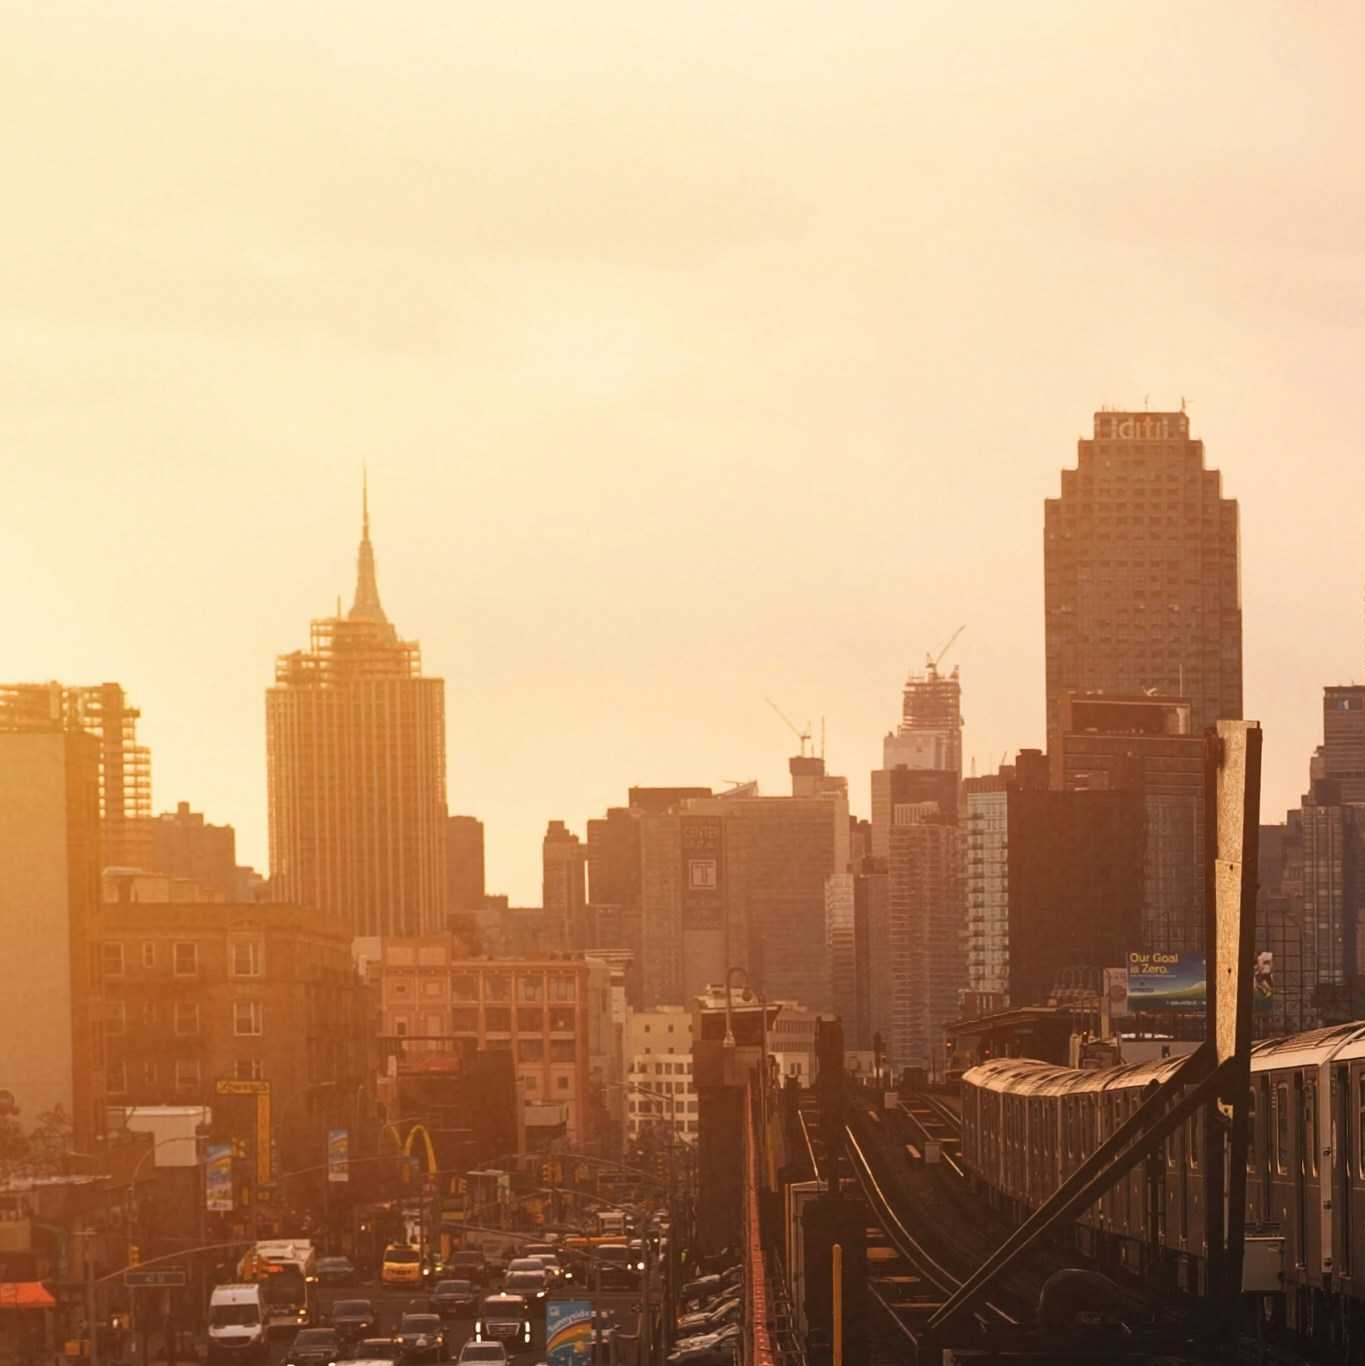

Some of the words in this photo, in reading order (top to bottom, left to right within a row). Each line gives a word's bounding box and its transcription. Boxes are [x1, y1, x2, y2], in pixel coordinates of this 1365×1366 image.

[1129, 952, 1150, 963] Our
[1153, 952, 1179, 963] Goal
[1130, 964, 1140, 974] is
